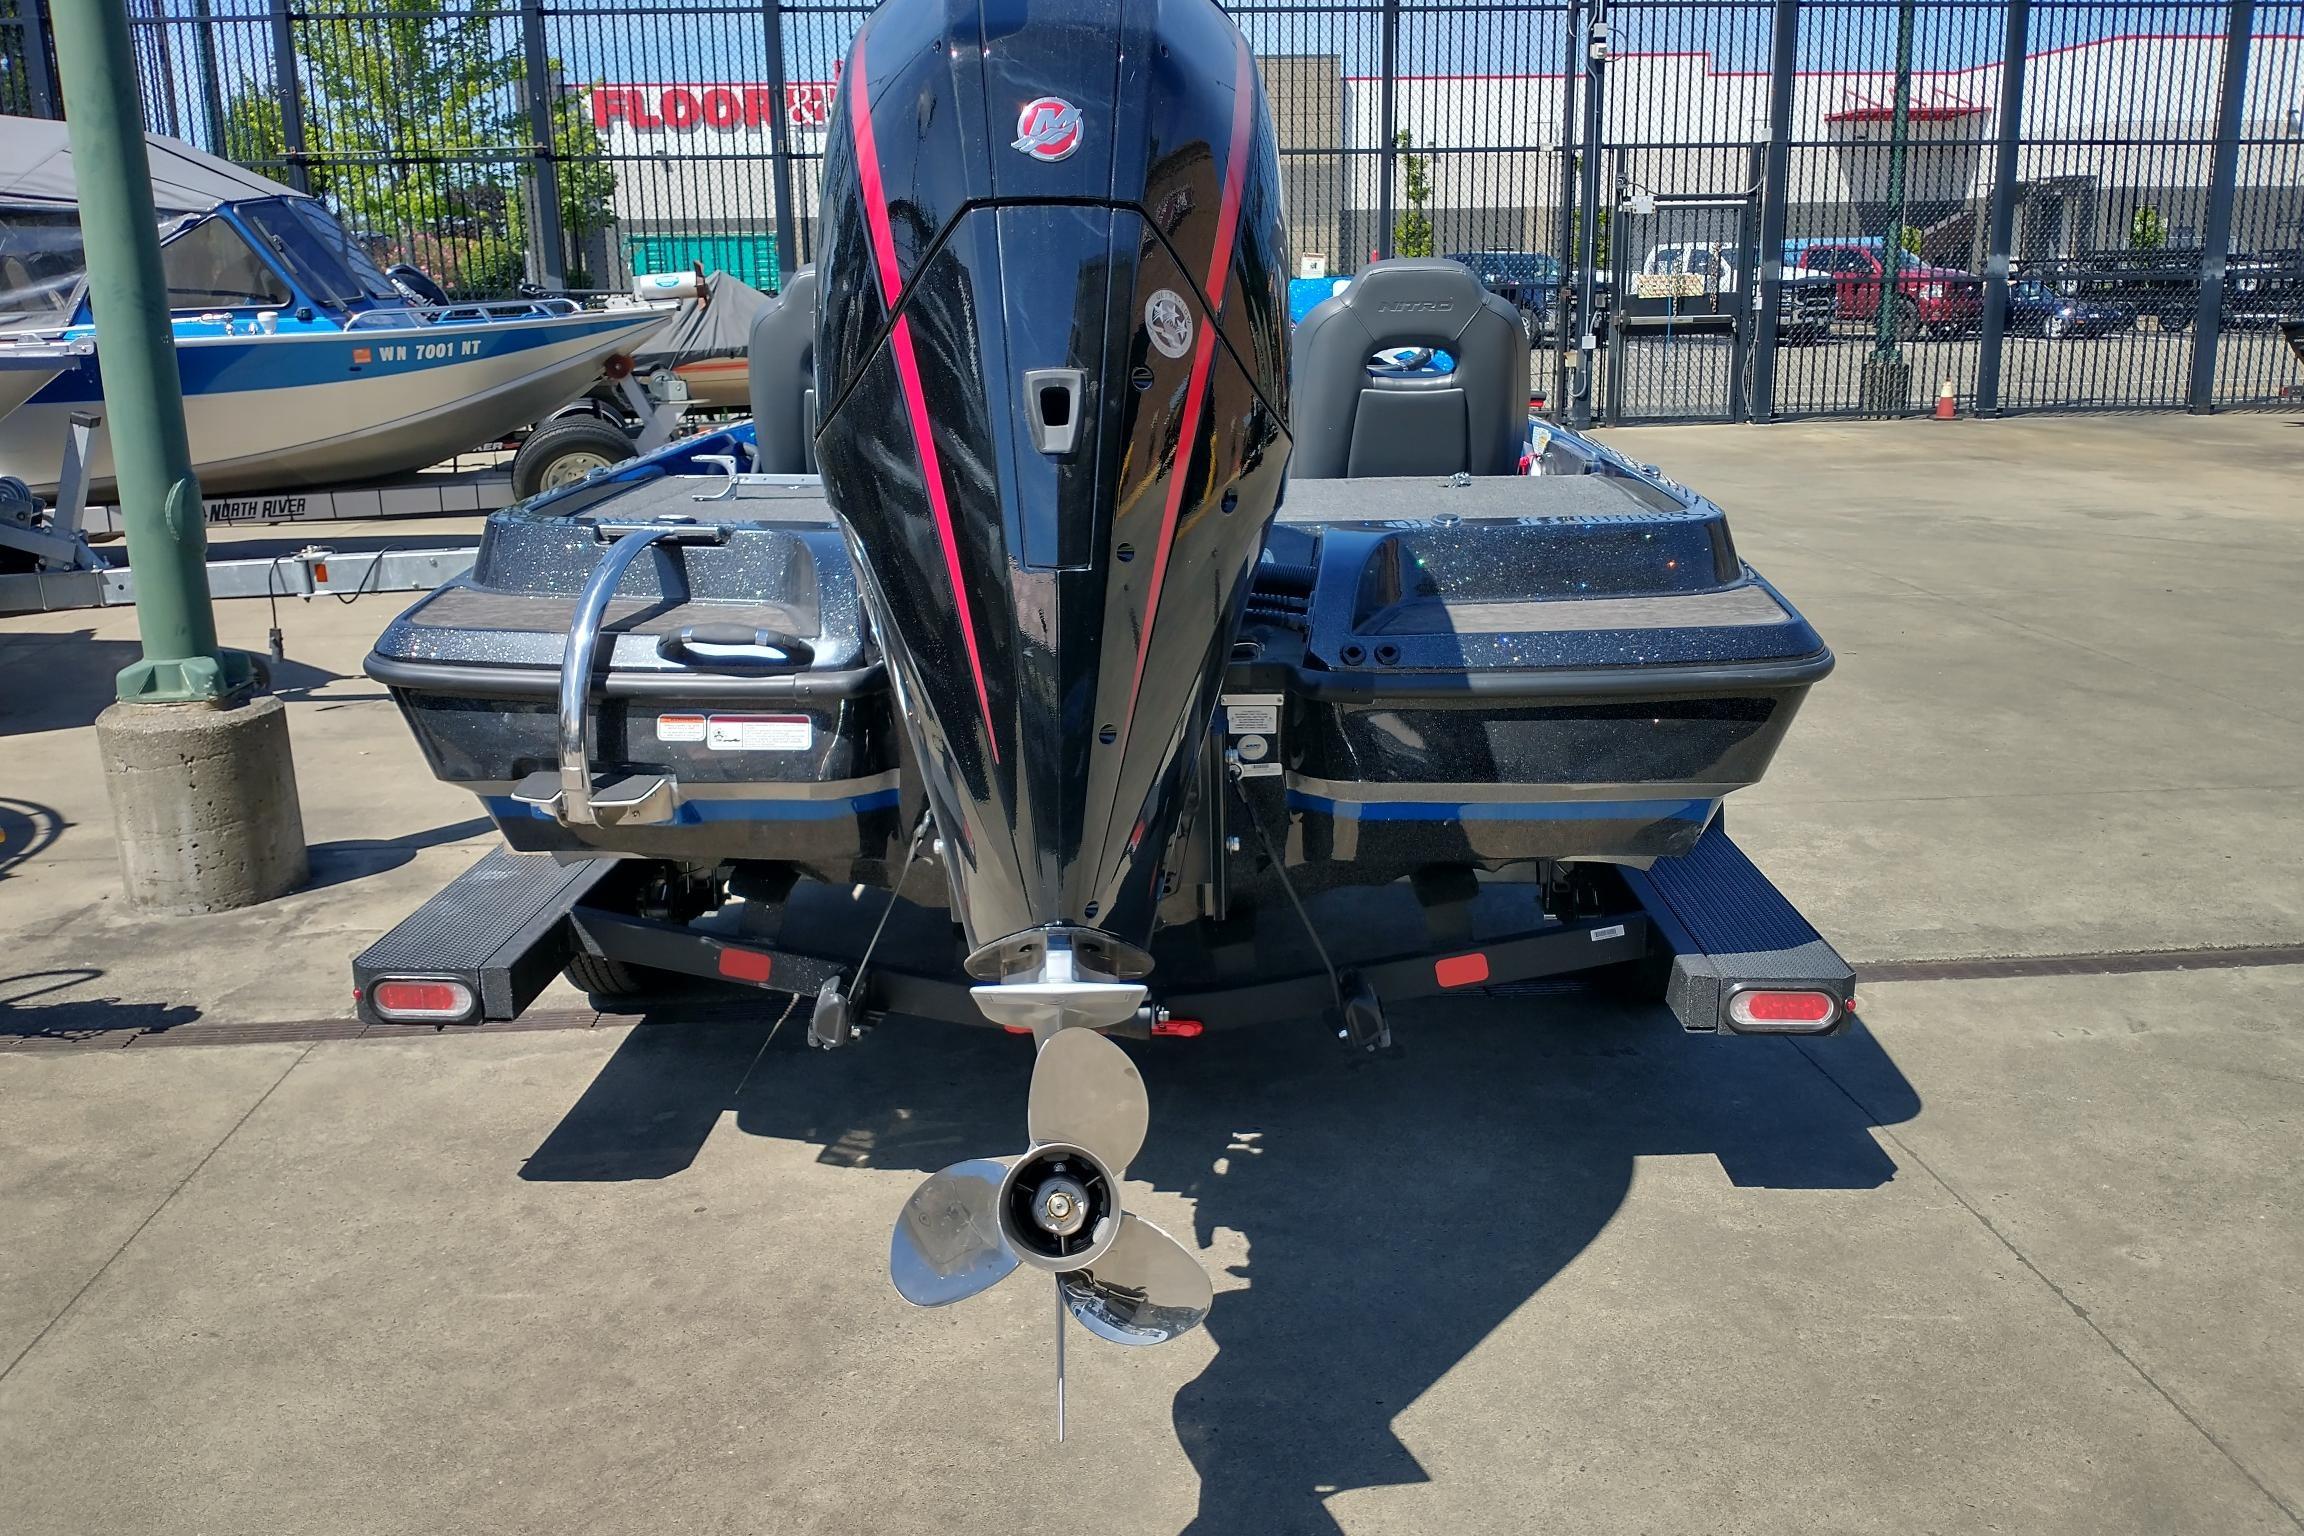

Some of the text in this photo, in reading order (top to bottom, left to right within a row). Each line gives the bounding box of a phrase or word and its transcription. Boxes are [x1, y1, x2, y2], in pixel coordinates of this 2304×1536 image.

[592, 88, 773, 130] FLOOR
[1377, 301, 1455, 313] NITRO
[378, 340, 482, 362] WN 7001 NT
[209, 498, 306, 522] NORTH RIVER
